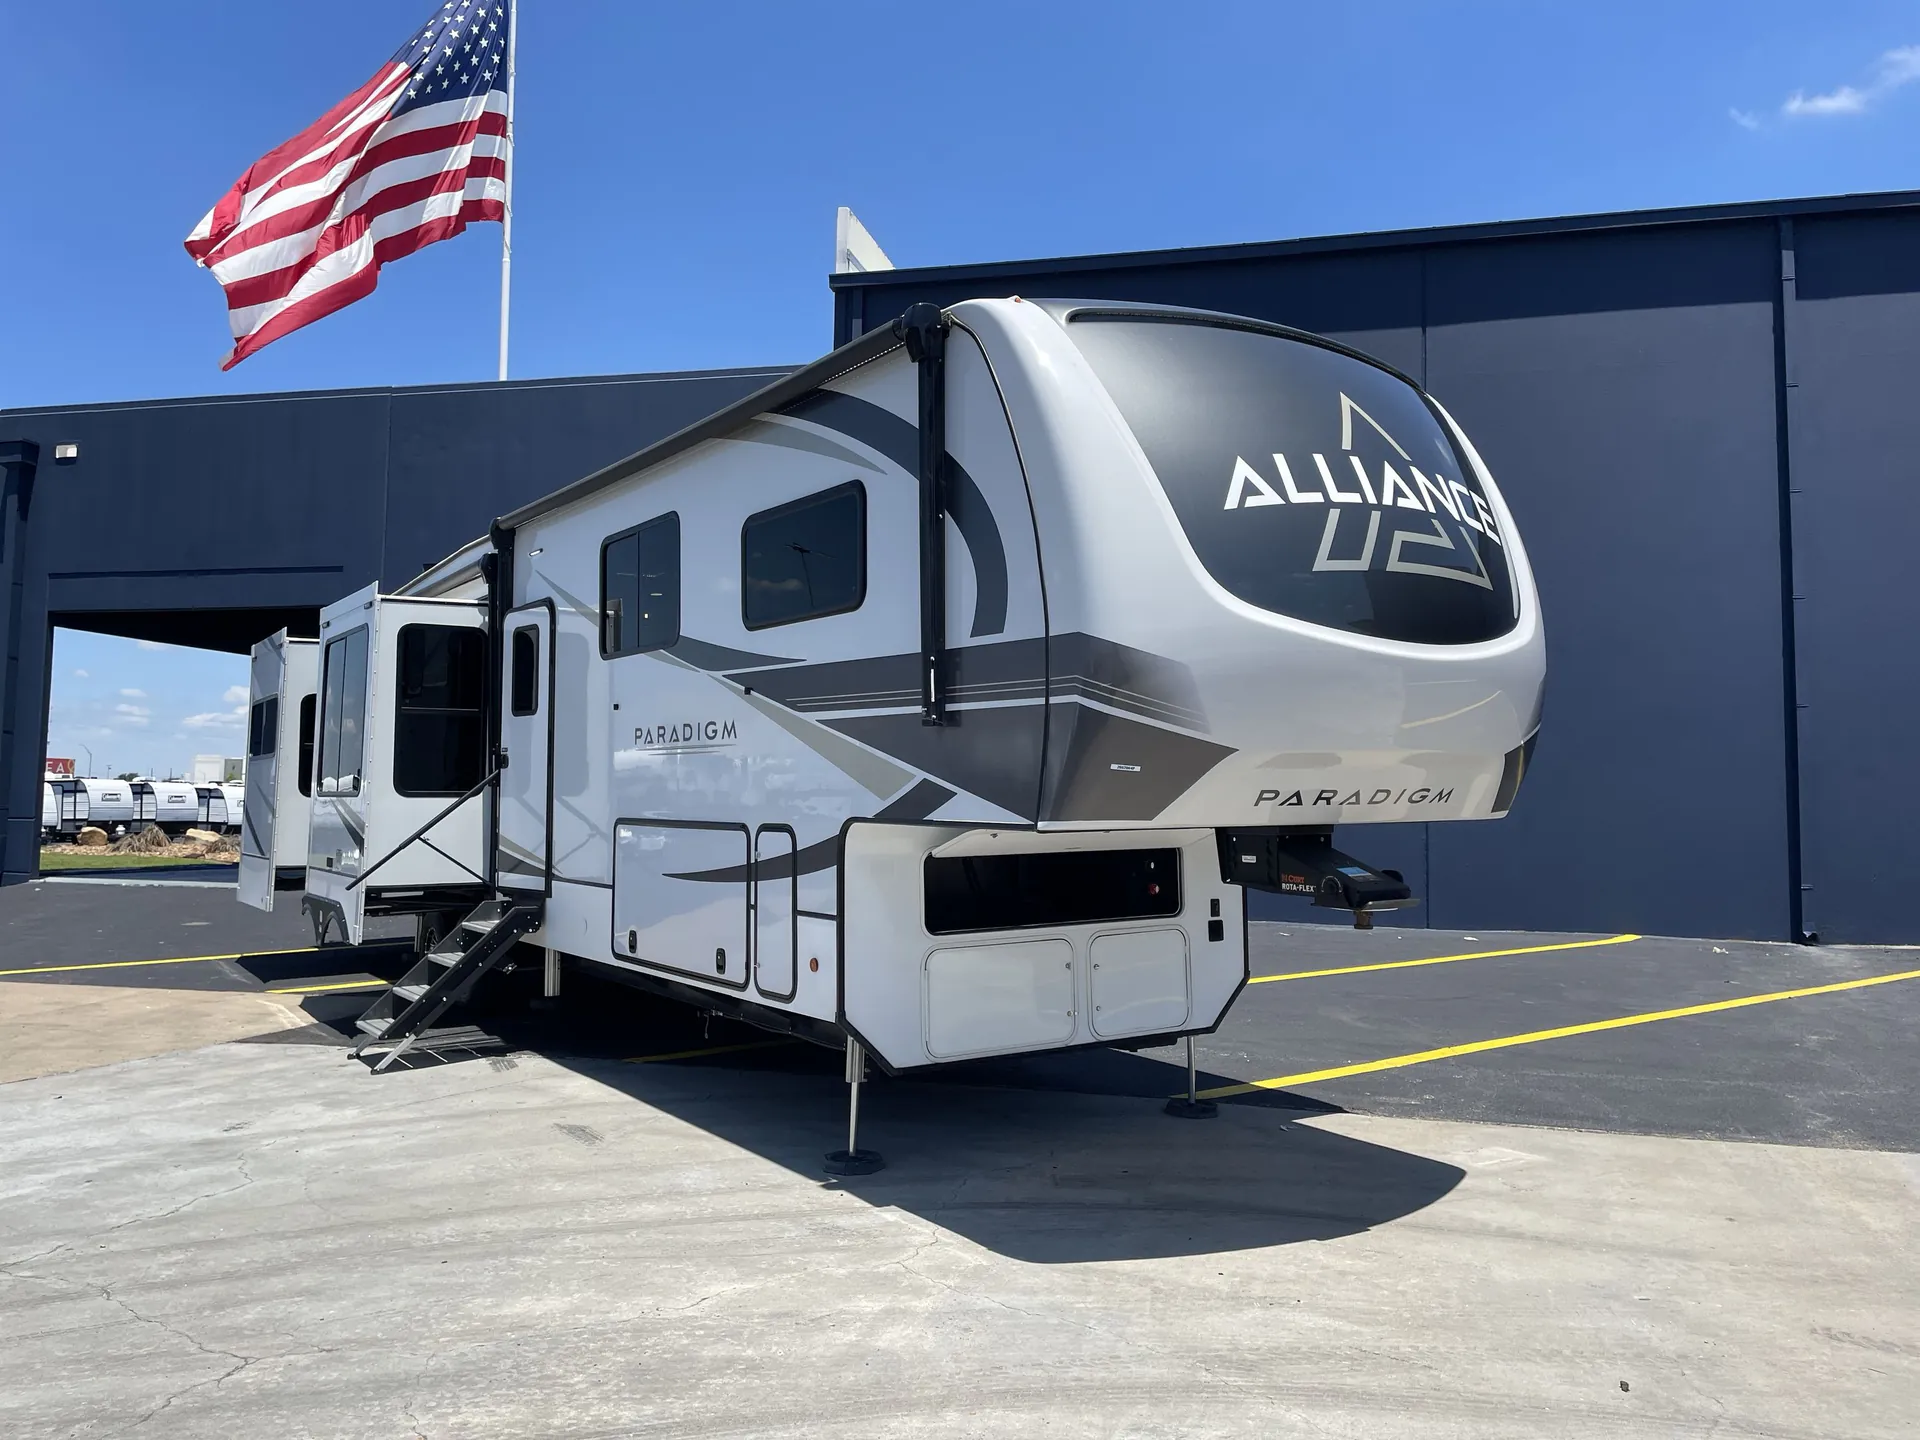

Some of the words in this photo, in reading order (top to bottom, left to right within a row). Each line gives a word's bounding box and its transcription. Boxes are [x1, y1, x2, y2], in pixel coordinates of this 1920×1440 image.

[1224, 453, 1501, 546] ALLIANCE
[634, 719, 738, 745] PARADIGM
[1253, 787, 1455, 806] PARADIGM
